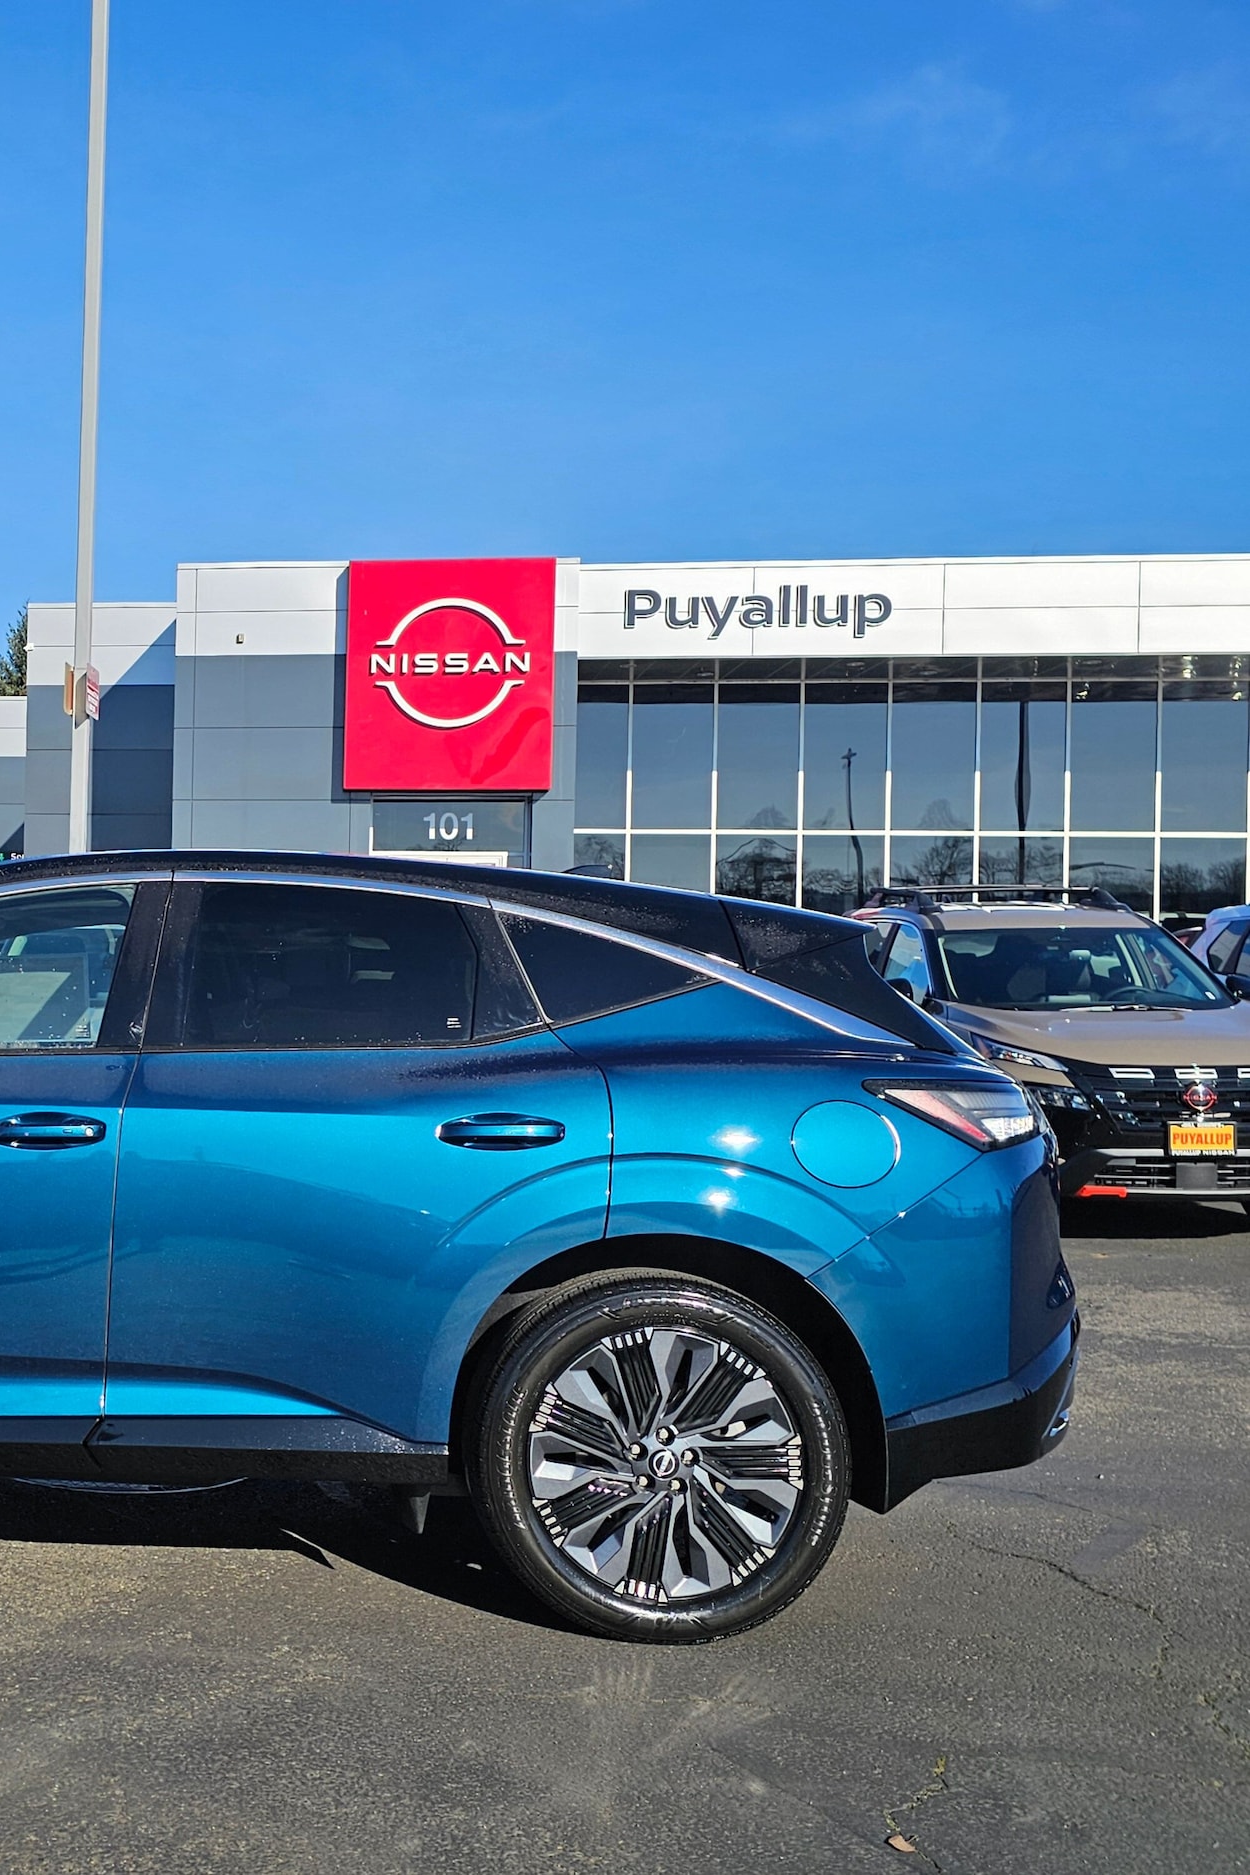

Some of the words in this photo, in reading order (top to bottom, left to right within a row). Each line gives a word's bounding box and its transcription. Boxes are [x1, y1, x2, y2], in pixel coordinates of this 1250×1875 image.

[624, 584, 893, 640] Puyallup
[369, 651, 531, 675] NISSAN
[423, 812, 473, 841] 101
[1172, 1132, 1232, 1145] PUYALLUP
